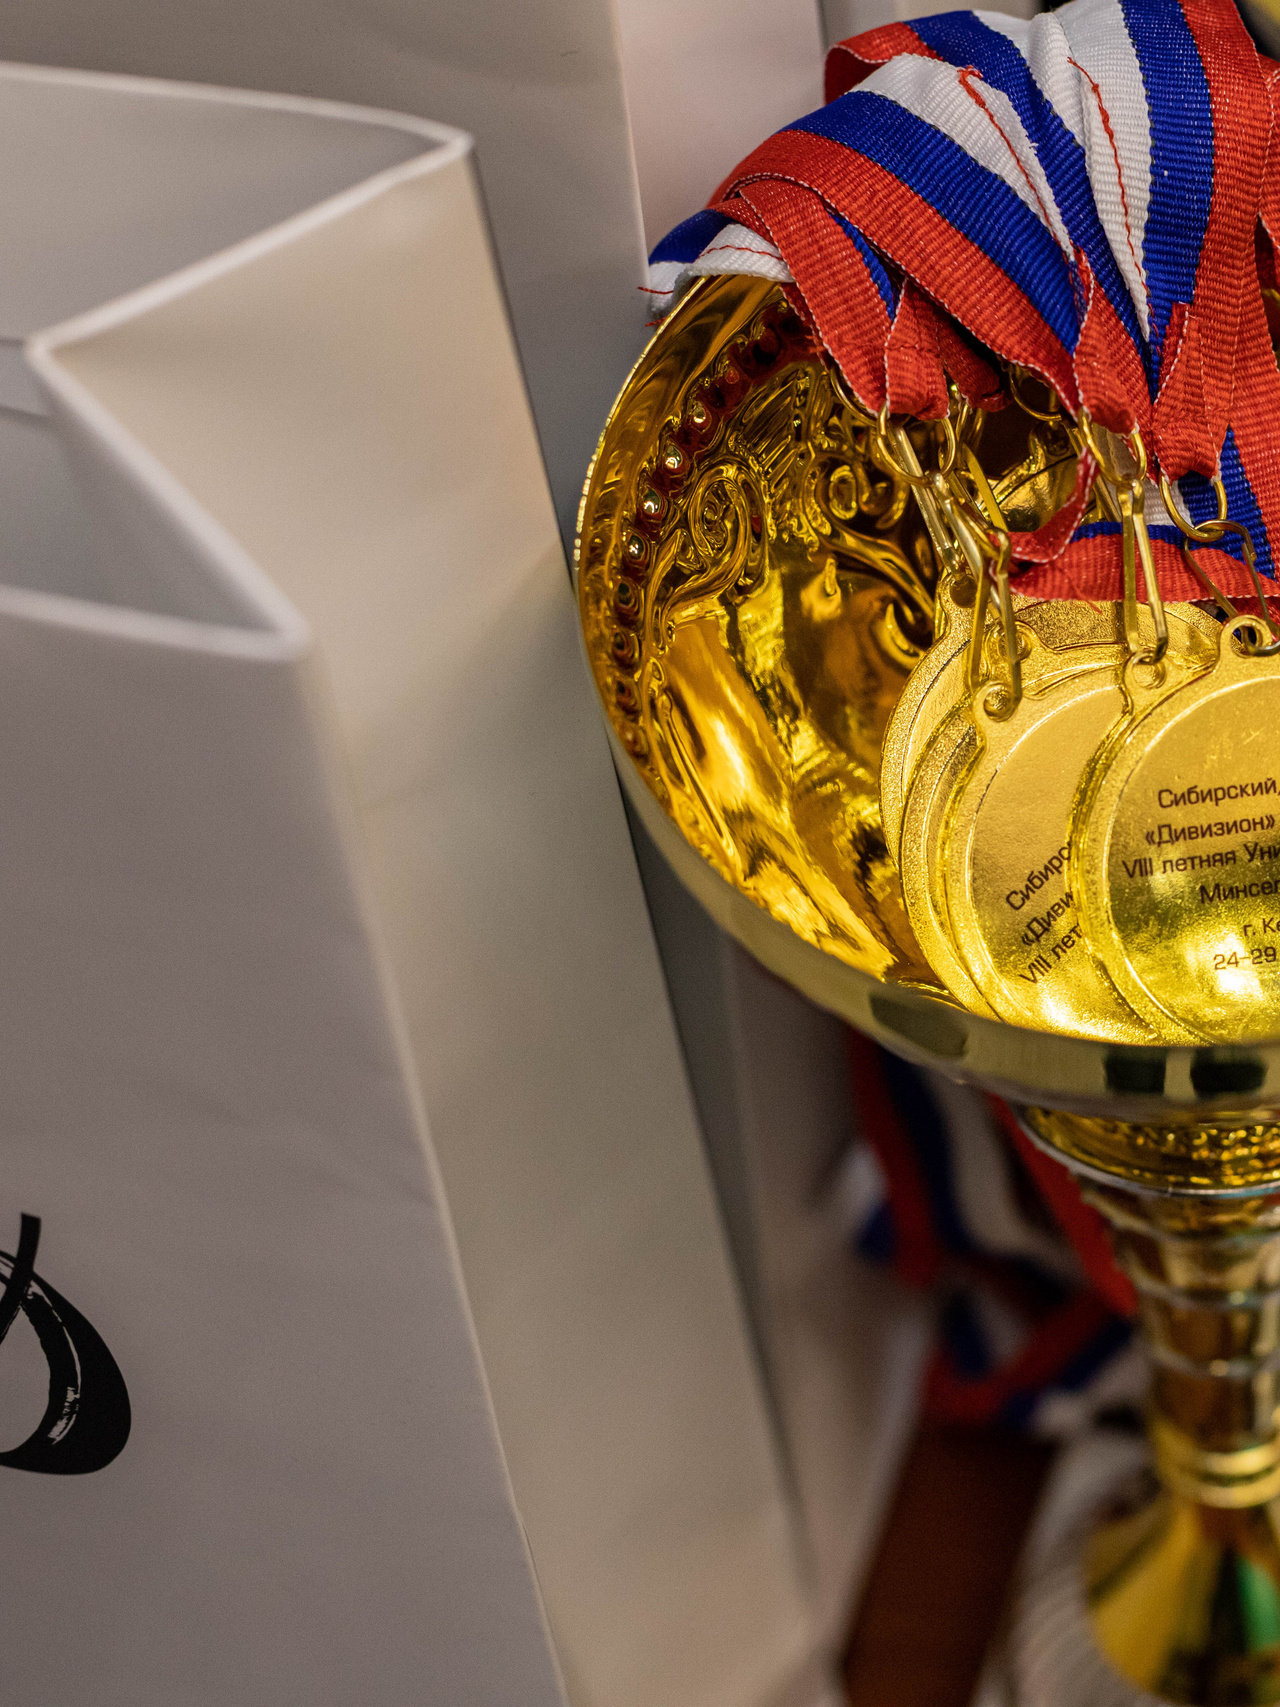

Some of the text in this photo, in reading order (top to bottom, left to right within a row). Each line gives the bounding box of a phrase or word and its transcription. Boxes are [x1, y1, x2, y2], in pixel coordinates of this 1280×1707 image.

[1145, 813, 1275, 847] «Дивизион»
[1005, 841, 1073, 911] Сибирс
[1122, 857, 1154, 879] VIII
[1162, 849, 1237, 875] летняя
[1243, 923, 1256, 938] г.
